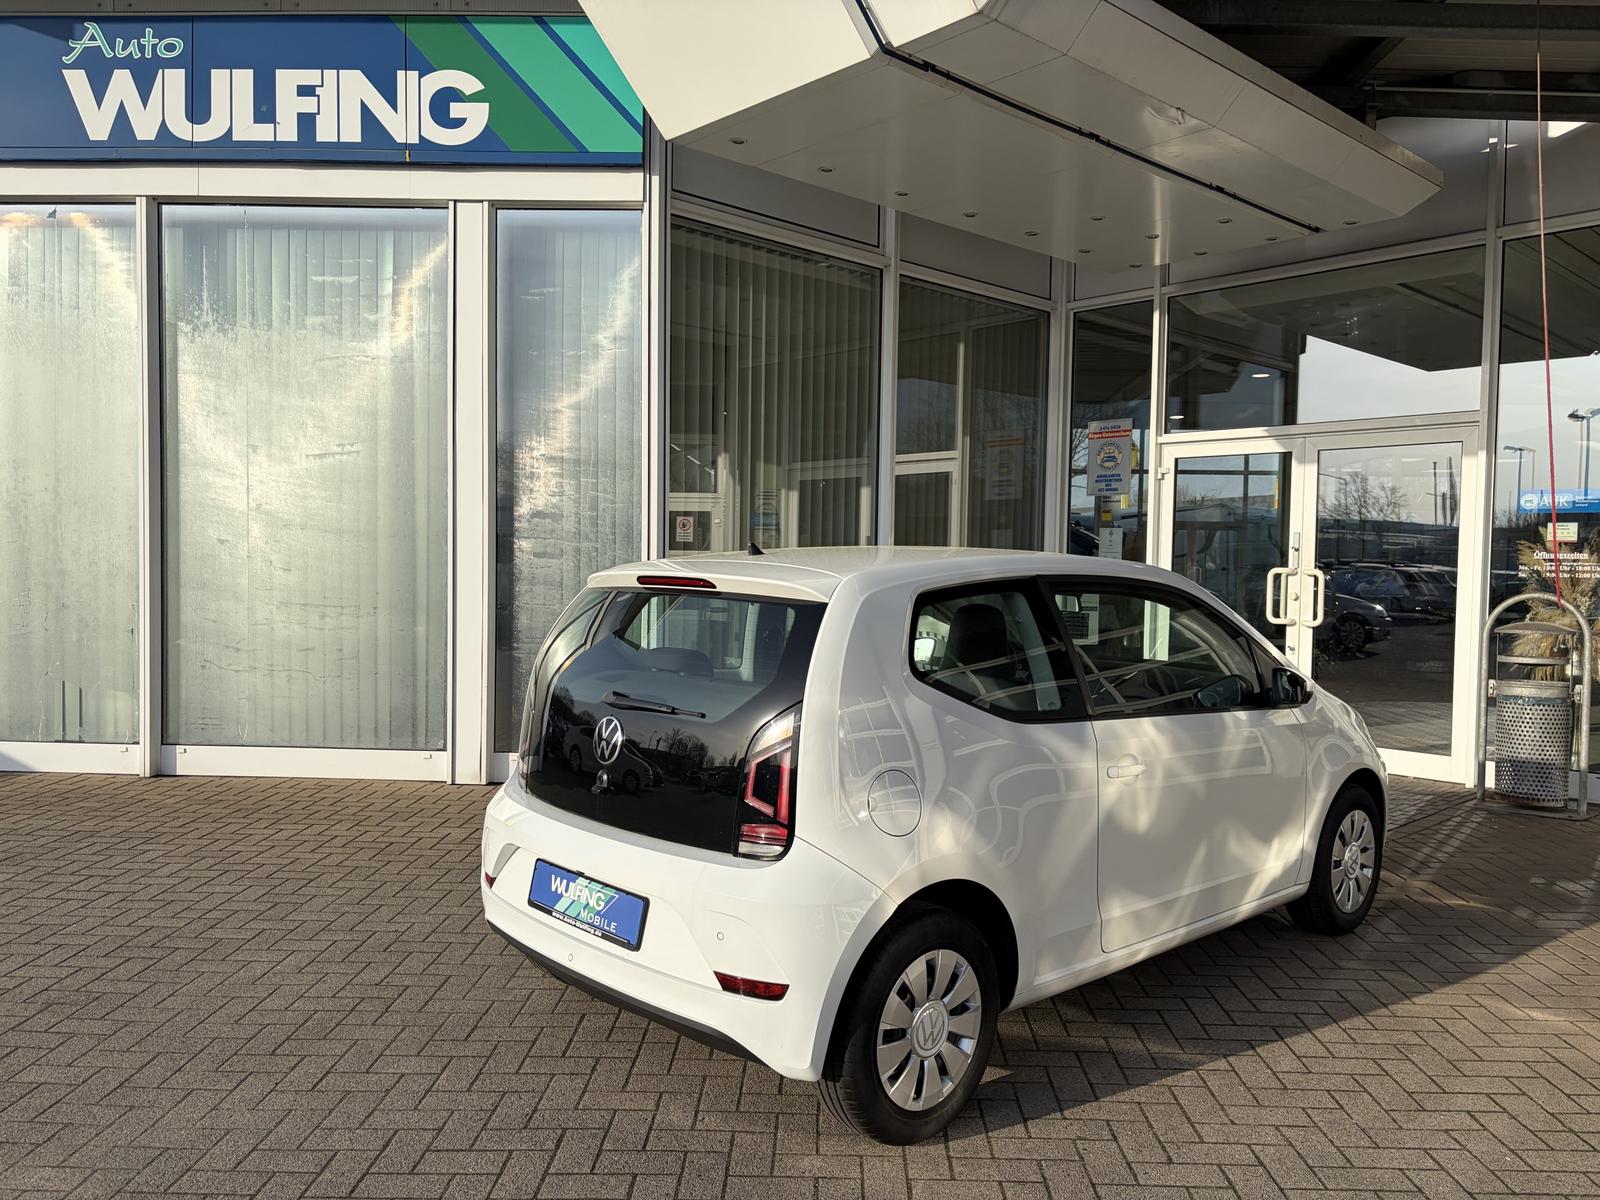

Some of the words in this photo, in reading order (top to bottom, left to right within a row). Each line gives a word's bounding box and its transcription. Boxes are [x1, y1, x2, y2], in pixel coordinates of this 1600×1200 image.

[62, 21, 185, 64] Auto
[62, 68, 490, 146] WULFING
[1533, 550, 1589, 559] Öffnugszeiten
[551, 874, 606, 911] WULFING
[579, 908, 618, 933] MOBILE
